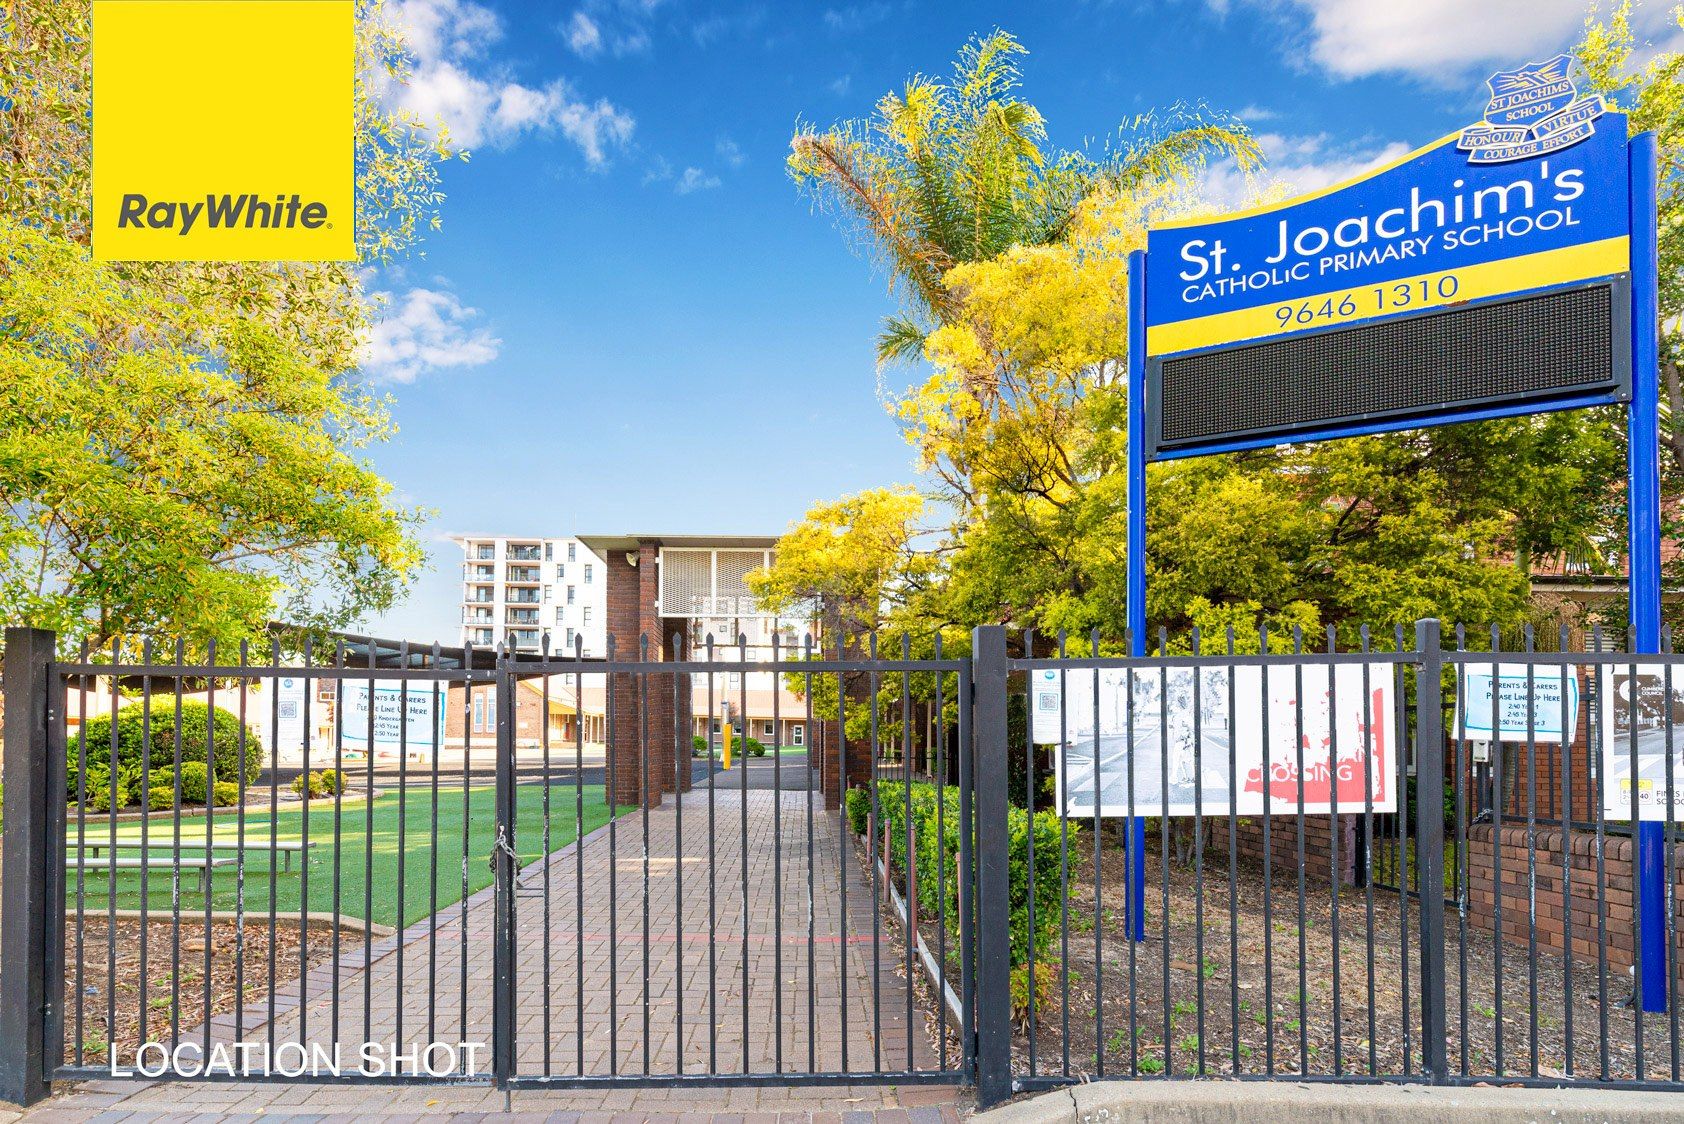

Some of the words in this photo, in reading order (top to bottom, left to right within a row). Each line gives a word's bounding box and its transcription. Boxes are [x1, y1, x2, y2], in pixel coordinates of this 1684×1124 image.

[1490, 98, 1504, 110] ST
[1507, 81, 1569, 108] JOACHIMS
[1465, 131, 1523, 146] HONOUR
[1542, 105, 1598, 133] VIRTUE
[1506, 102, 1554, 122] SCHOOL
[1483, 143, 1538, 160] COURAGE
[1542, 127, 1584, 149] EFFORT
[1180, 239, 1241, 282] St.
[1265, 161, 1585, 264] Joachim's
[1320, 235, 1433, 276] PRIMARY
[1443, 206, 1581, 250] SCHOOL
[1275, 294, 1356, 329] 9646
[1374, 275, 1459, 310] 1310
[389, 694, 396, 702] &
[1488, 681, 1520, 689] PRENTS
[1531, 682, 1558, 690] ARERS
[1543, 694, 1560, 702] HERE
[380, 704, 395, 713] LINE
[409, 706, 428, 715] HERE
